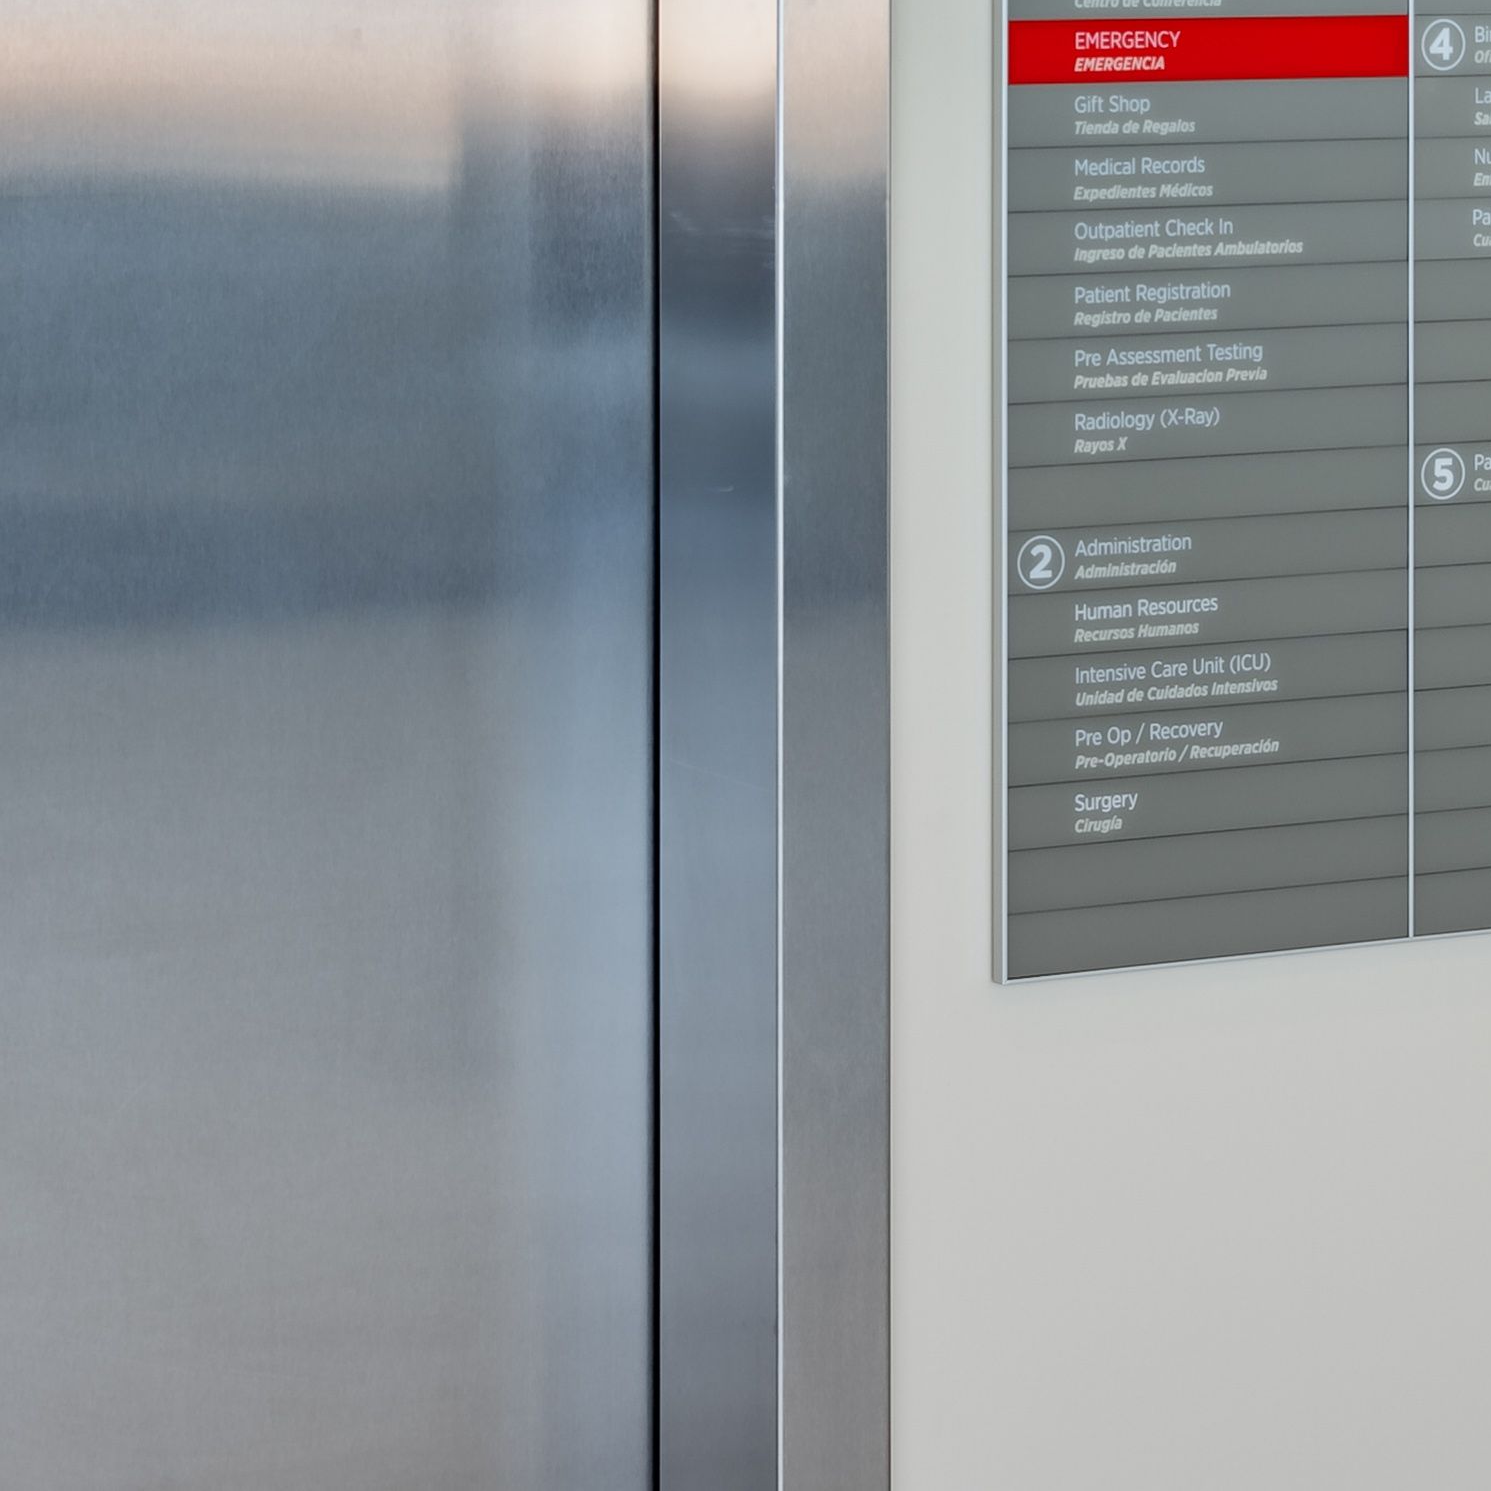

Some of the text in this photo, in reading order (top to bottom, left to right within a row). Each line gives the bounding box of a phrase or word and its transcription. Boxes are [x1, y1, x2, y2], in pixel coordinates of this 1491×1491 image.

[1076, 31, 1180, 49] EMERGENCY
[1429, 27, 1453, 60] 4
[1074, 56, 1164, 72] EMERGENCIA
[1075, 95, 1150, 114] Gift Shop
[1075, 119, 1195, 135] Tienda de Regalos
[1075, 156, 1205, 176] Medical Records
[1074, 183, 1213, 202] Expedientes Médicos
[1075, 218, 1233, 241] Outpatient Check In
[1074, 239, 1303, 263] Ingreso de Pacientes Ambulatorios
[1075, 281, 1230, 304] Patient Registration
[1074, 307, 1217, 327] Registro de Pacientes
[1075, 343, 1263, 367] Pre Assessment Testing
[1074, 373, 1128, 389] Pruebas
[1131, 372, 1148, 386] de
[1075, 407, 1220, 430] Radiology (X-Ray)
[1074, 437, 1128, 454] Rayos X
[1433, 458, 1454, 491] 5
[1075, 534, 1191, 557] Administration
[1029, 545, 1052, 579] 2
[1074, 559, 1176, 579] Administración
[1075, 598, 1218, 621] Human Resources
[1074, 623, 1199, 642] Recursos Humanos
[1076, 653, 1271, 684] Intensive Care Unit (ICU)
[1076, 678, 1278, 706] Unidad de Cuidados Intensivos
[1076, 722, 1223, 746] Pre Op / Recovery
[1075, 739, 1279, 769] Pre-Operatorio / Recuperación
[1075, 793, 1138, 812] Surgery
[1075, 815, 1122, 833] Cirugía
